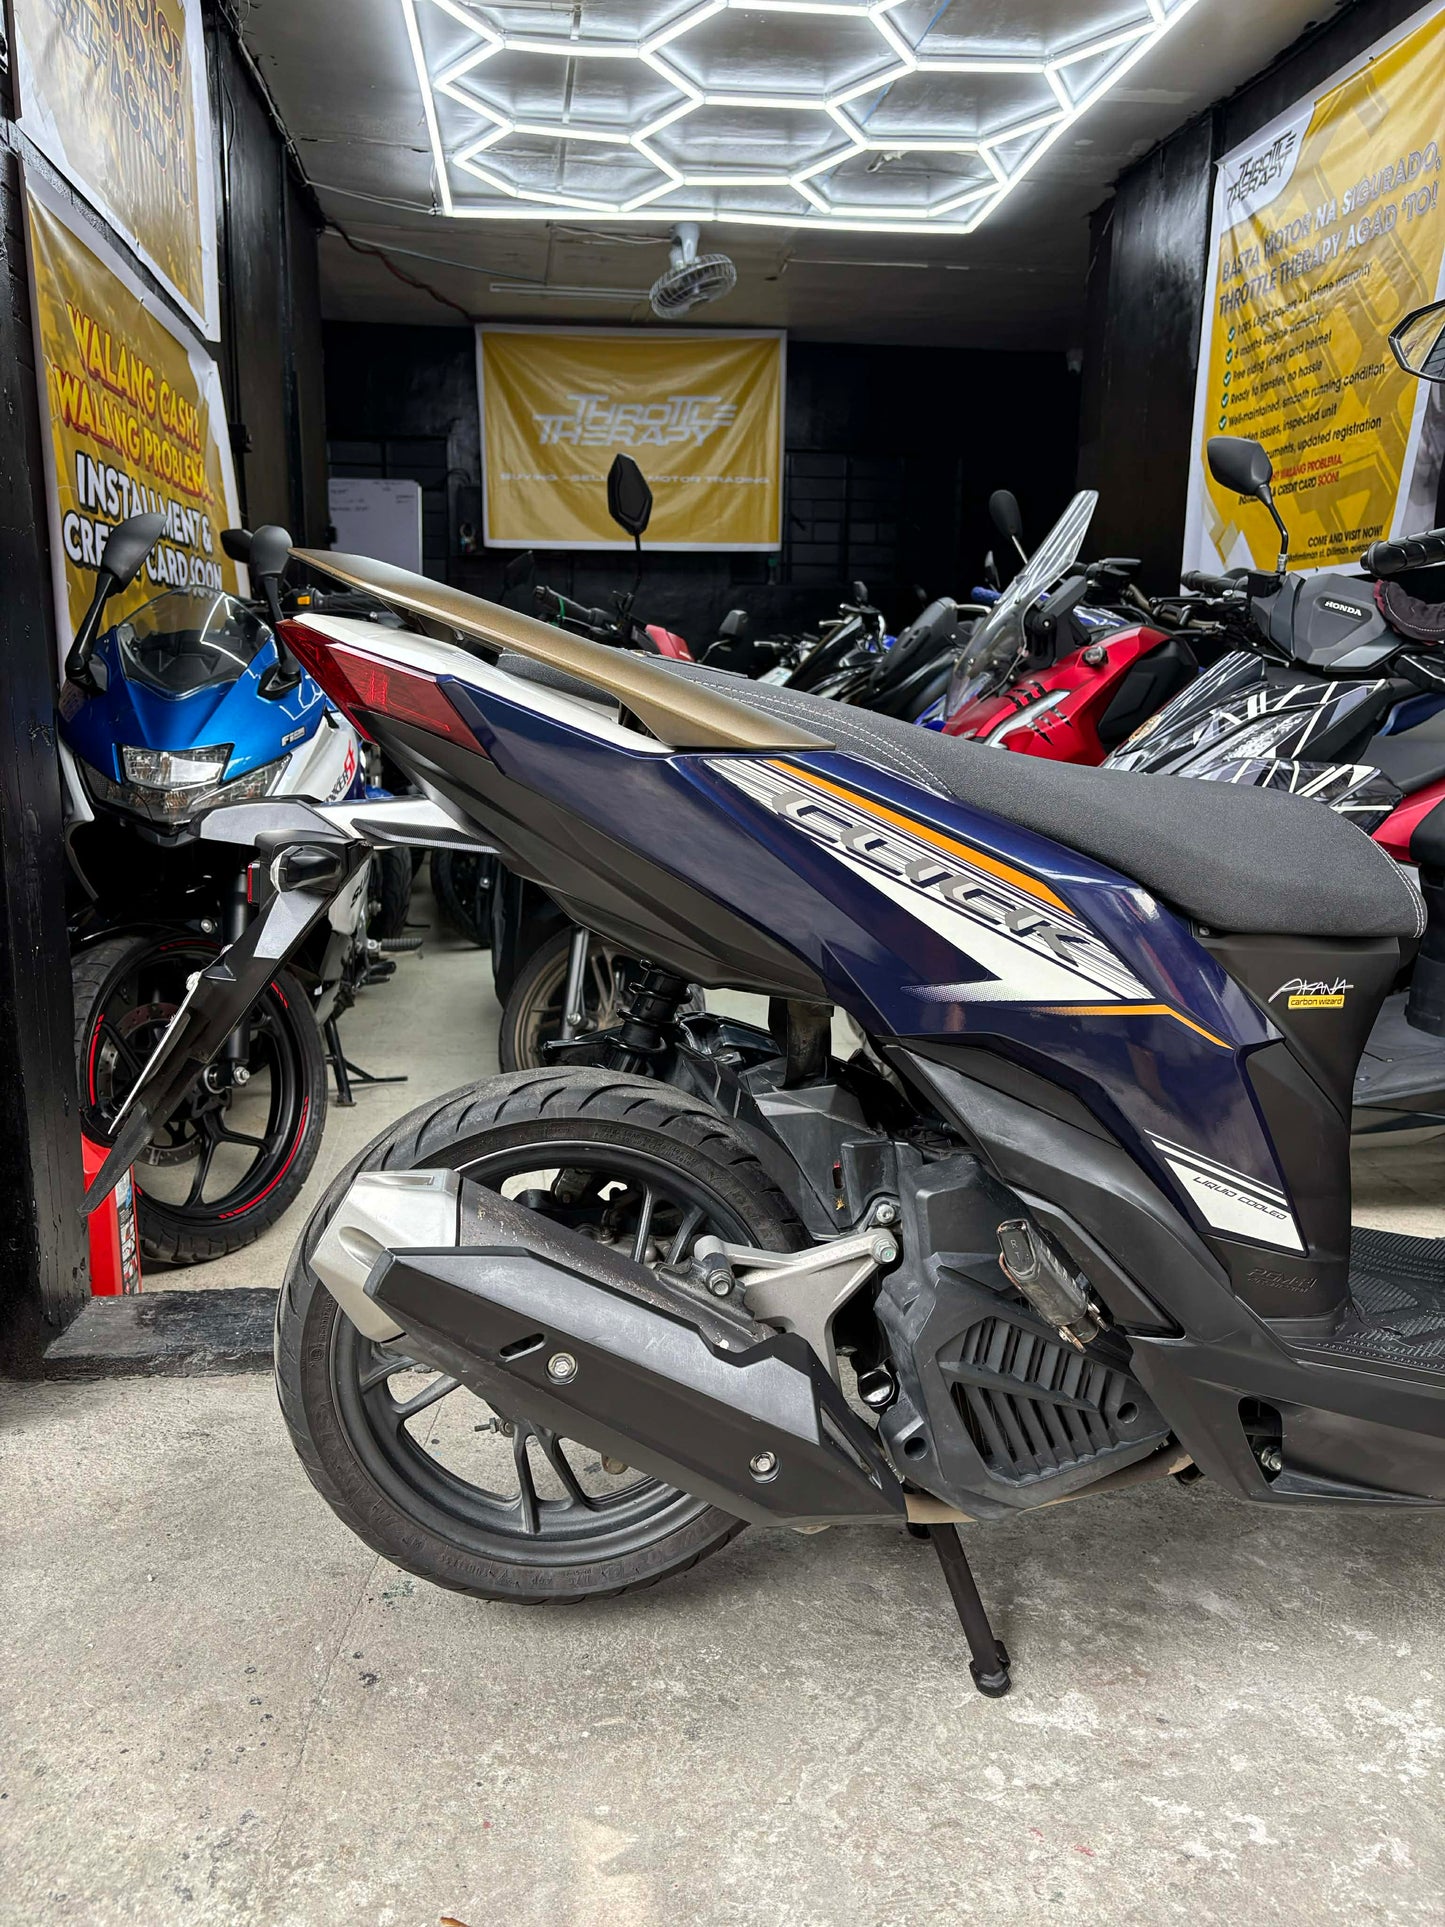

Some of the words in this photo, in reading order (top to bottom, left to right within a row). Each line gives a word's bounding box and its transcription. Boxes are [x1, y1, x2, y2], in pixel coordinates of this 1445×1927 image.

[110, 47, 167, 172] AGAD
[1239, 130, 1297, 183] THROTTLE
[1227, 151, 1287, 210] THERAPY
[1221, 246, 1260, 285] BASTA
[1263, 211, 1312, 259] MOTOR
[1314, 200, 1337, 229] NA
[1341, 140, 1442, 215] SIGURADO,
[1219, 268, 1277, 317] THROTTLE
[1280, 231, 1343, 284] THERAPY
[1344, 203, 1398, 253] AGAD
[1336, 264, 1372, 287] warranty
[66, 300, 157, 421] WALANG
[1288, 342, 1304, 358] and
[1305, 330, 1332, 352] helmet
[1282, 389, 1310, 410] smooth
[1311, 374, 1342, 399] running
[1343, 362, 1386, 387] condition
[1287, 369, 1298, 381] no
[1298, 359, 1323, 378] hassle
[54, 365, 142, 467] WALANG
[567, 393, 738, 428] THROTTLE
[1283, 409, 1321, 432] inspected
[1322, 403, 1338, 418] unit
[533, 414, 718, 446] THERAPY
[1297, 432, 1331, 453] updated
[1332, 416, 1383, 443] registration
[500, 472, 558, 483] BUYING
[703, 475, 770, 485] TRADING
[1278, 480, 1299, 495] CREDIT
[1299, 475, 1316, 491] CARD
[75, 450, 201, 549] INSTALLMENT
[202, 513, 214, 553] &
[1308, 535, 1327, 547] COME
[1329, 532, 1343, 544] AND
[1344, 528, 1361, 541] VISIT
[1363, 525, 1384, 538] NOW!
[145, 542, 188, 588] CARD
[1324, 600, 1362, 617] HONDA
[772, 790, 1089, 967] CLICK
[1268, 977, 1354, 1003] AKANA
[1290, 998, 1317, 1006] carbon
[1318, 997, 1343, 1005] wizard
[1193, 1176, 1236, 1198] LIQUID
[1238, 1196, 1287, 1220] COOLED
